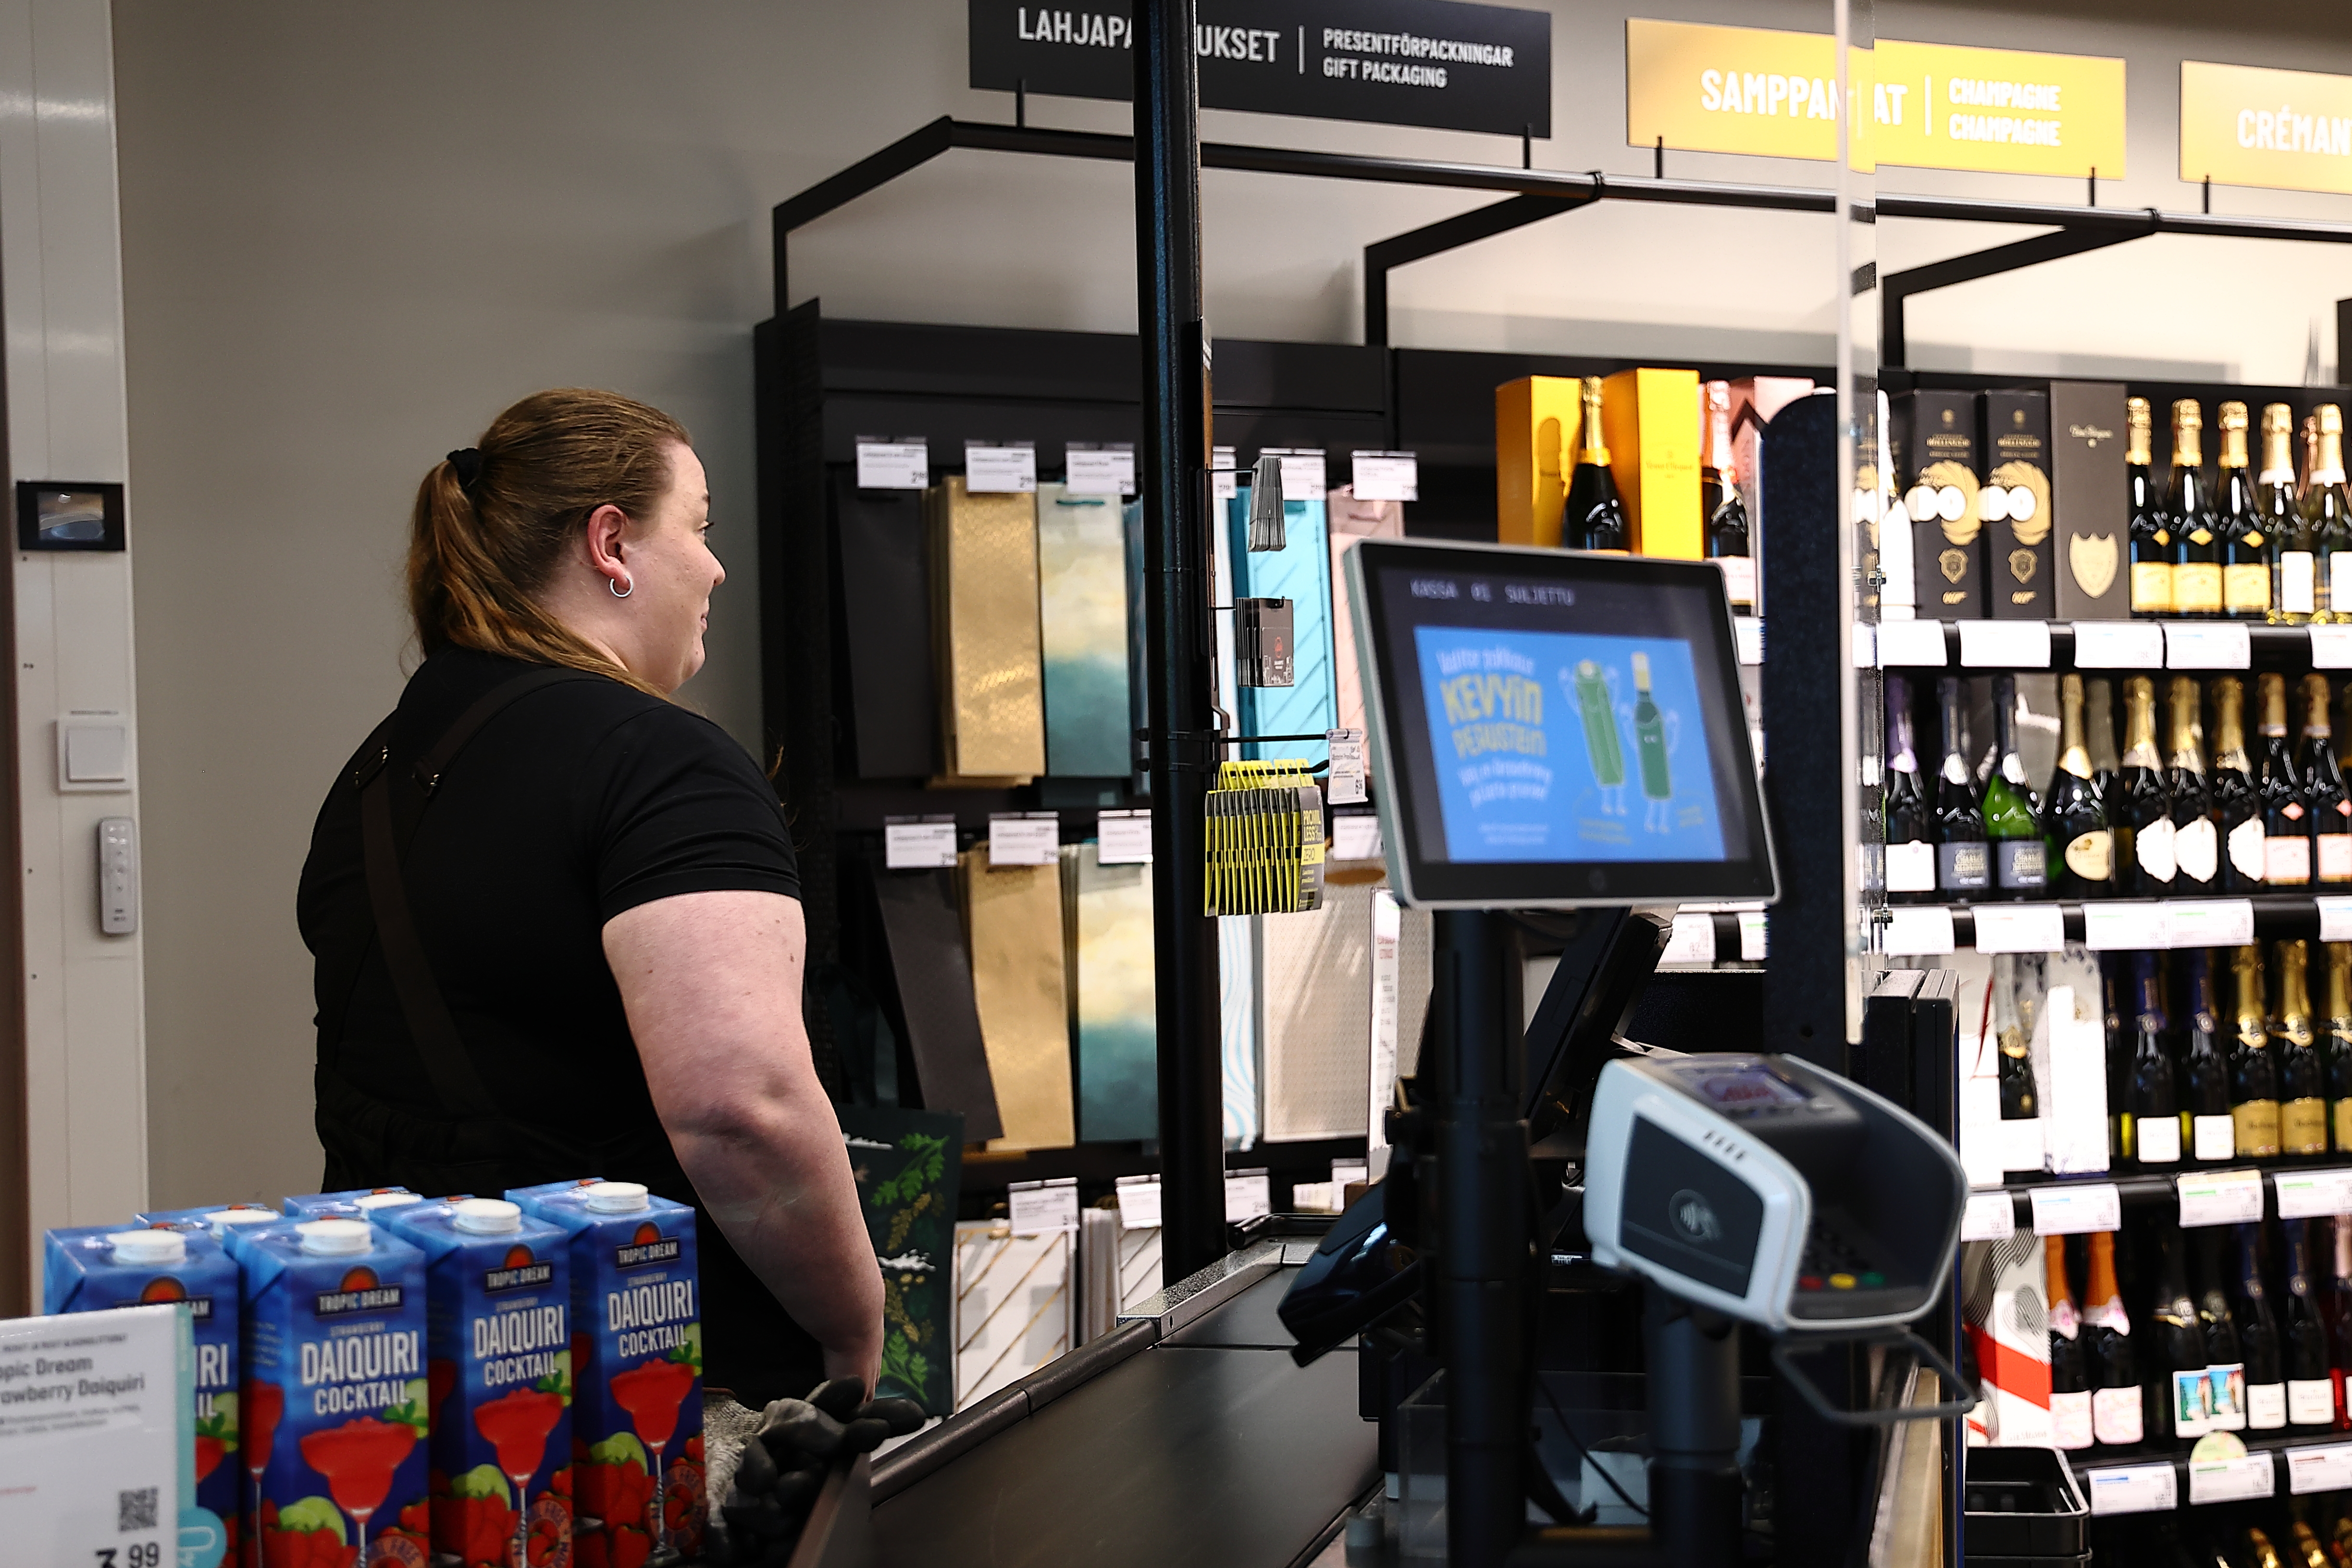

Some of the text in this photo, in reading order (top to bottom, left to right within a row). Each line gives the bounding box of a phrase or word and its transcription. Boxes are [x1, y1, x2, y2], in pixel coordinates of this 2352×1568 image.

[1018, 7, 1281, 63] LAHJAPUKSET
[1323, 27, 1514, 68] PRESENTFÖRPACKNINGAR
[1323, 56, 1448, 88] GIFT PACKAGING
[1700, 68, 1909, 125] SAMPPANAT
[1949, 77, 2062, 112] CHAMPAGNE
[1949, 112, 2062, 147] CHAMPAGNE
[2237, 103, 2352, 157] CRÉMAN
[1410, 579, 1459, 599] KASSA
[607, 1279, 693, 1332] DAIQUIRI
[473, 1304, 565, 1359] DAIQUIRI
[618, 1323, 689, 1358] COCKTAIL
[35, 1357, 93, 1376] Dream
[301, 1330, 419, 1386] DAIQUIRI
[484, 1351, 558, 1387] COCKTAIL
[77, 1373, 147, 1396] Daiquiri
[314, 1379, 411, 1415] COCKTAIL
